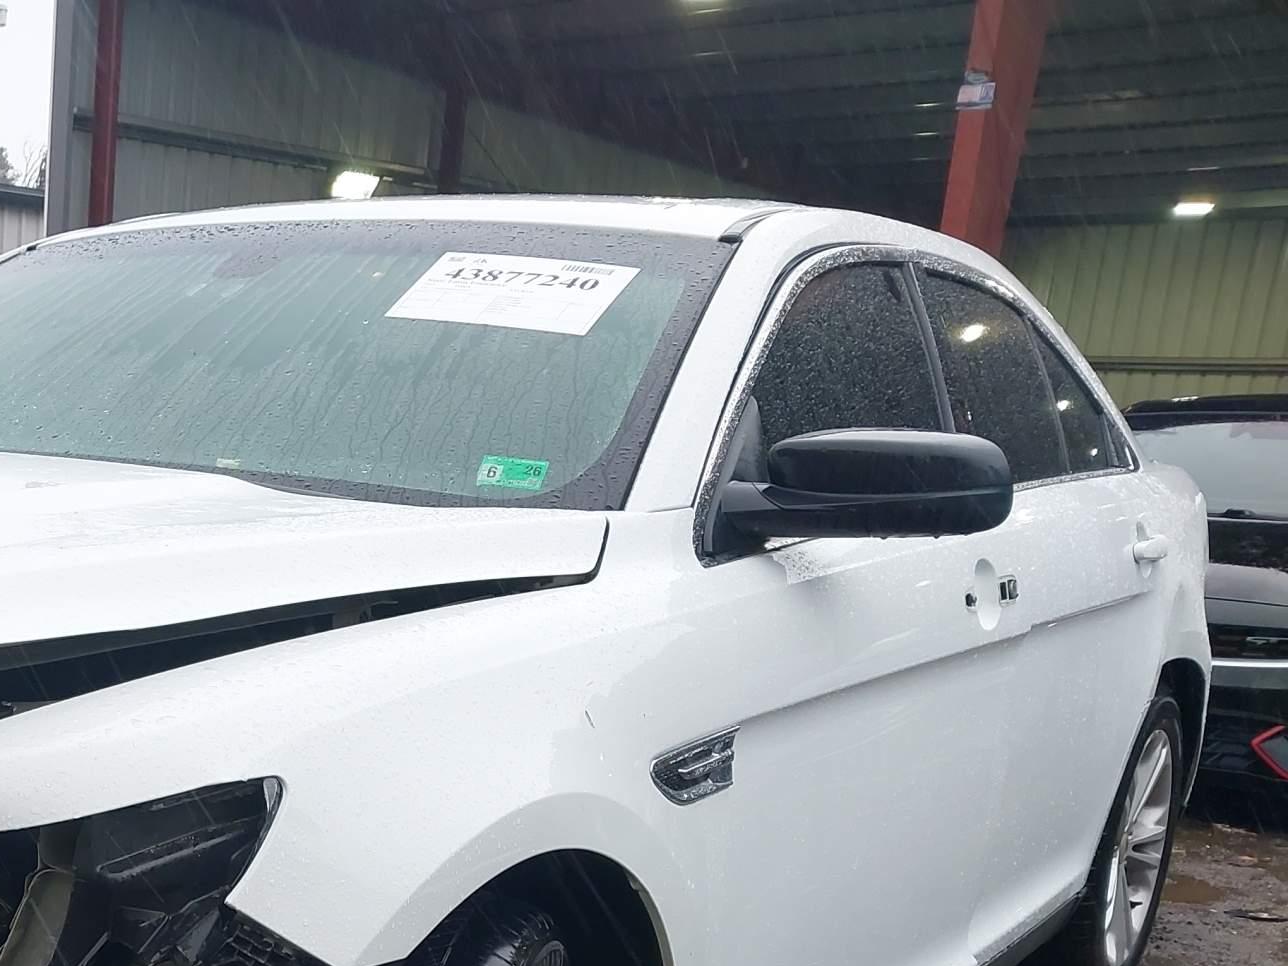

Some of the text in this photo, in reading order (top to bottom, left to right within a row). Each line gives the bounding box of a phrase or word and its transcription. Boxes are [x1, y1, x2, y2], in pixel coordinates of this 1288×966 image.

[444, 266, 601, 292] 43877240
[487, 465, 542, 478] 6 26
